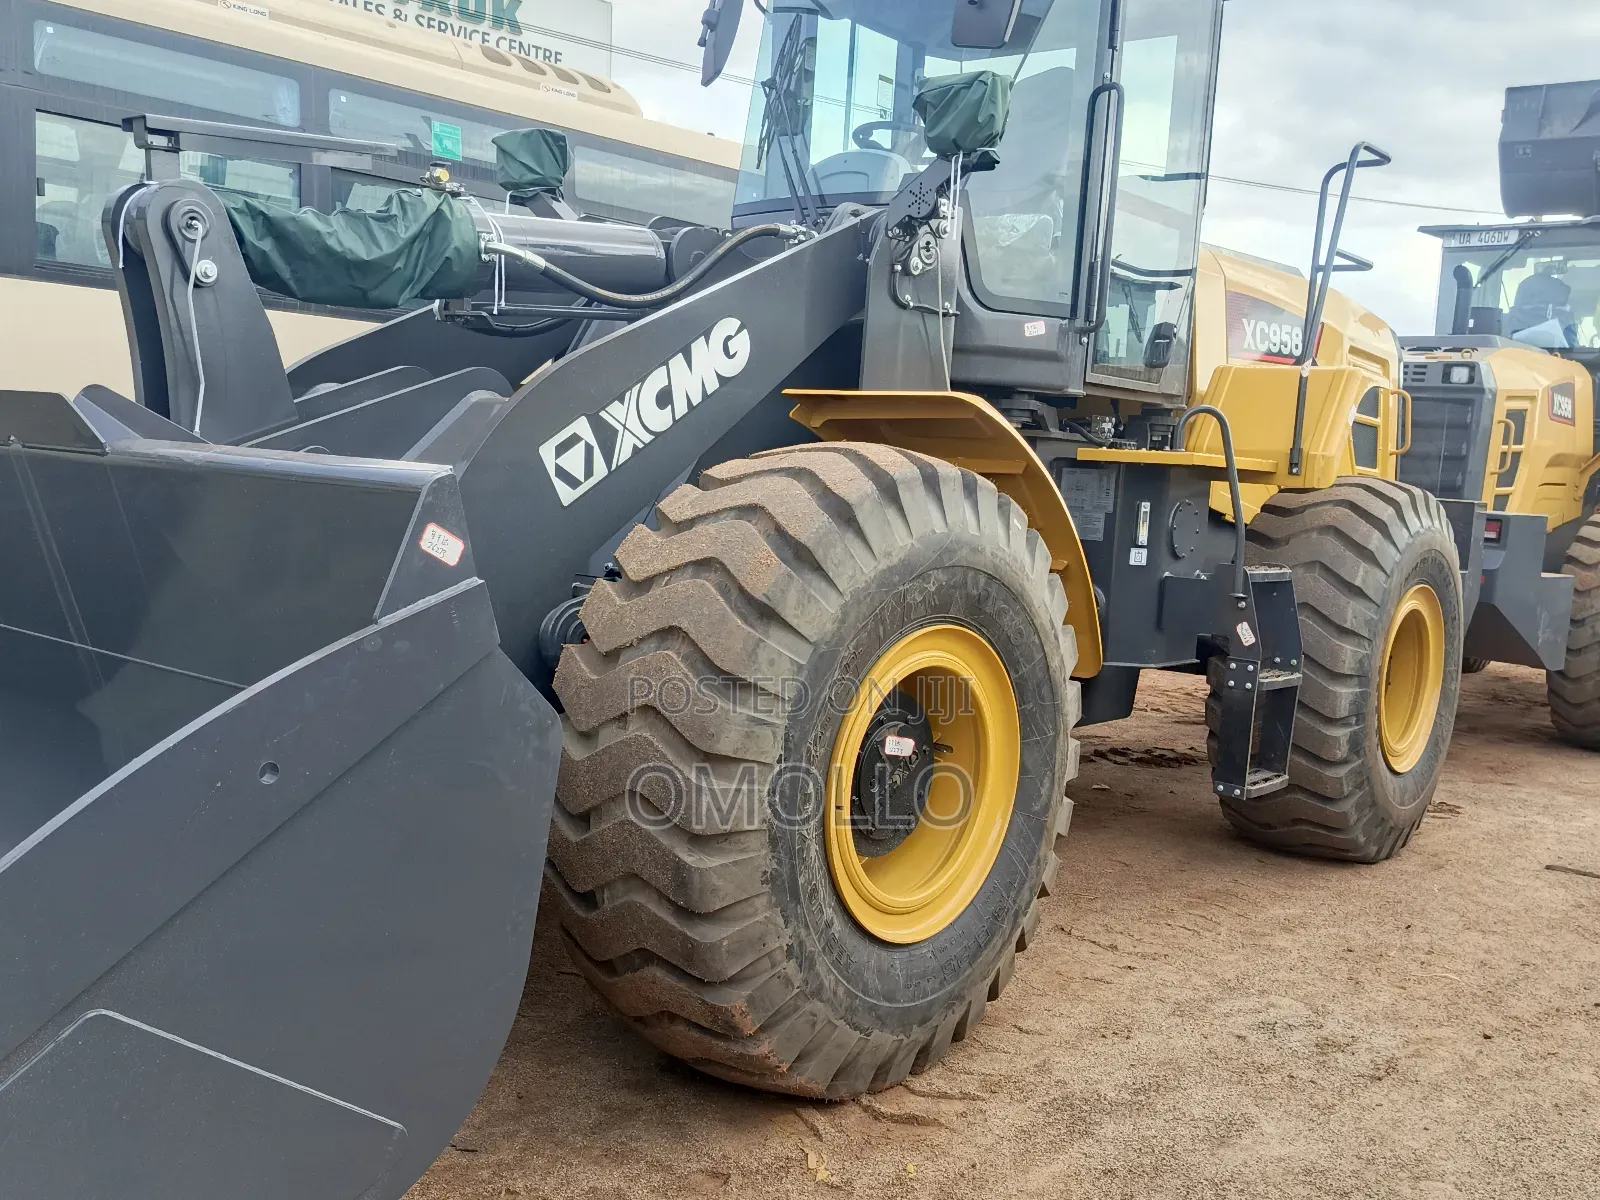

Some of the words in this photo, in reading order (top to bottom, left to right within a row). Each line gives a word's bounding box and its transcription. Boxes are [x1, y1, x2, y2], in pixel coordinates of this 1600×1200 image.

[414, 13, 490, 44] SERVICE
[495, 36, 563, 64] CENTRE
[1458, 231, 1471, 245] UA
[1241, 317, 1303, 357] XC958
[598, 317, 751, 472] XCMG
